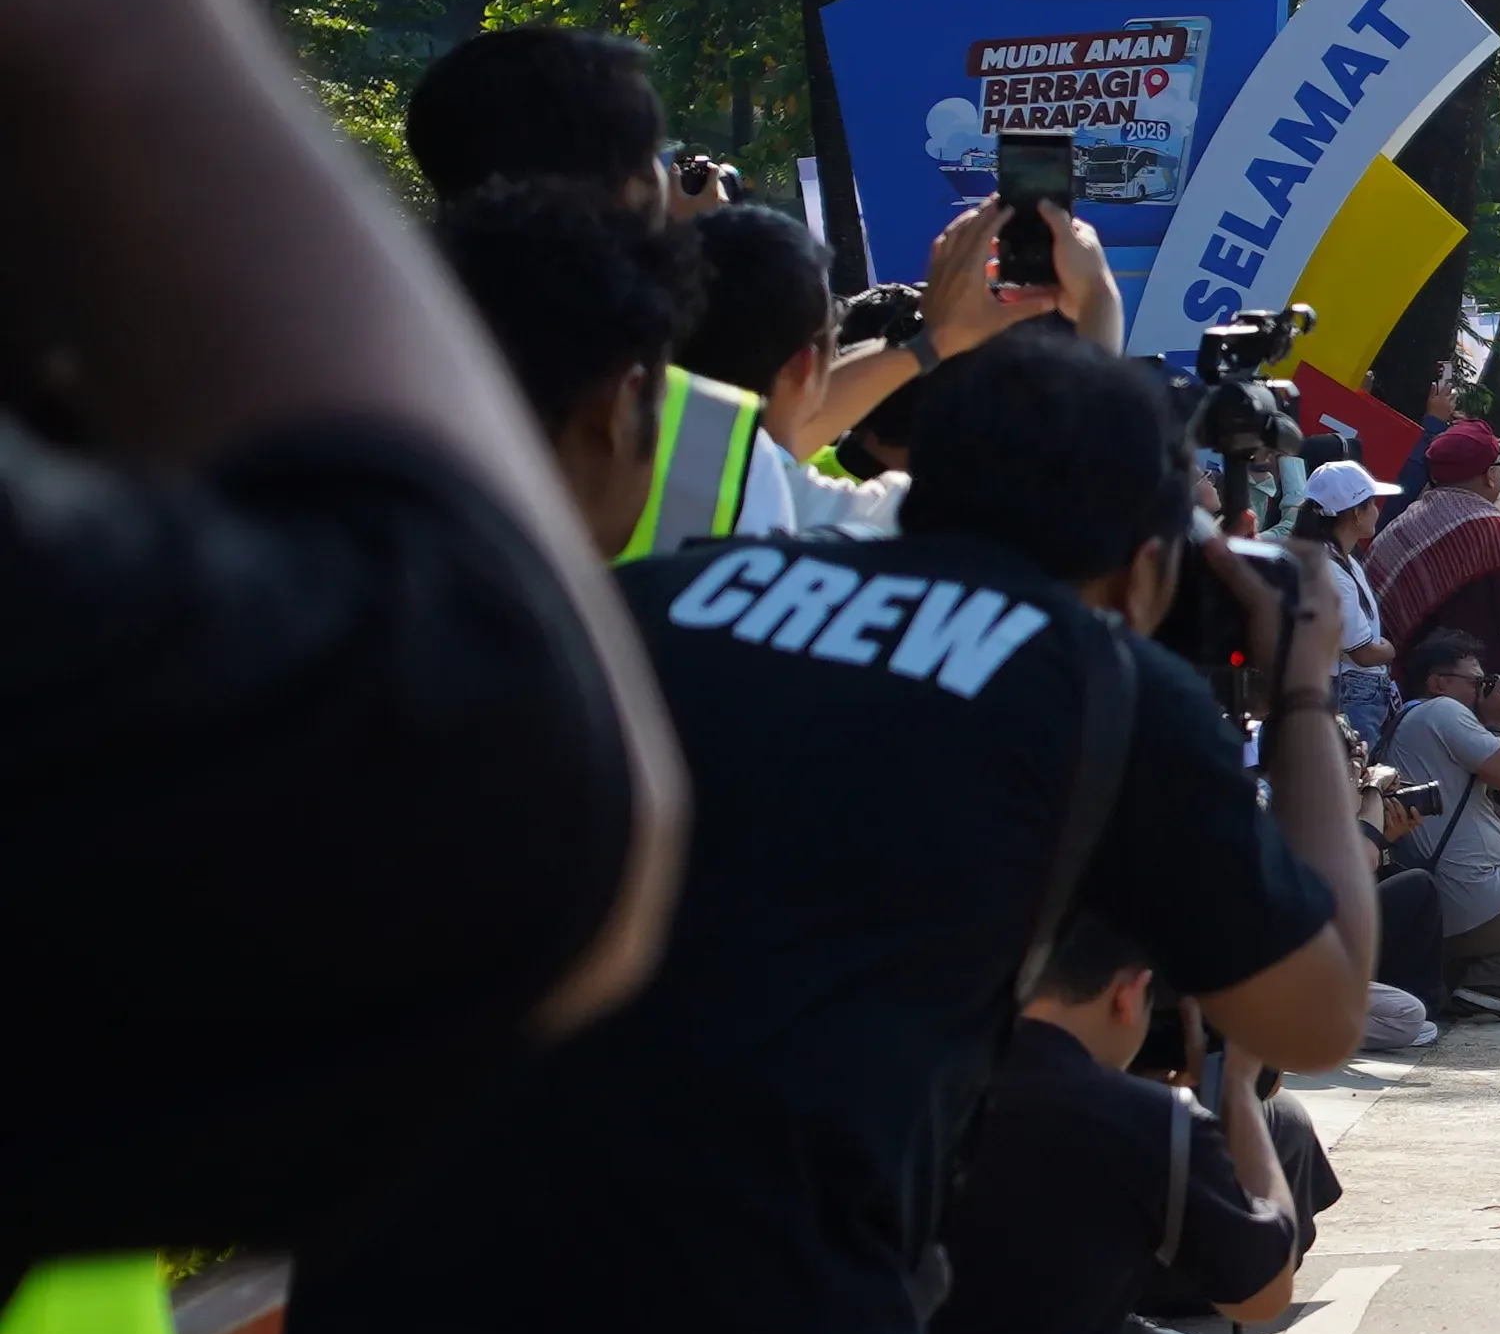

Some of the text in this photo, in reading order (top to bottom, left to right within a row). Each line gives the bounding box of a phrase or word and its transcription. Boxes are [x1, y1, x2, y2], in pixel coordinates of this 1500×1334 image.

[981, 34, 1175, 71] MUDIK AMAN
[984, 69, 1143, 107] BERBAGI
[981, 99, 1137, 135] HARAPAN
[1125, 121, 1167, 141] 2026
[668, 546, 1051, 700] CREW
